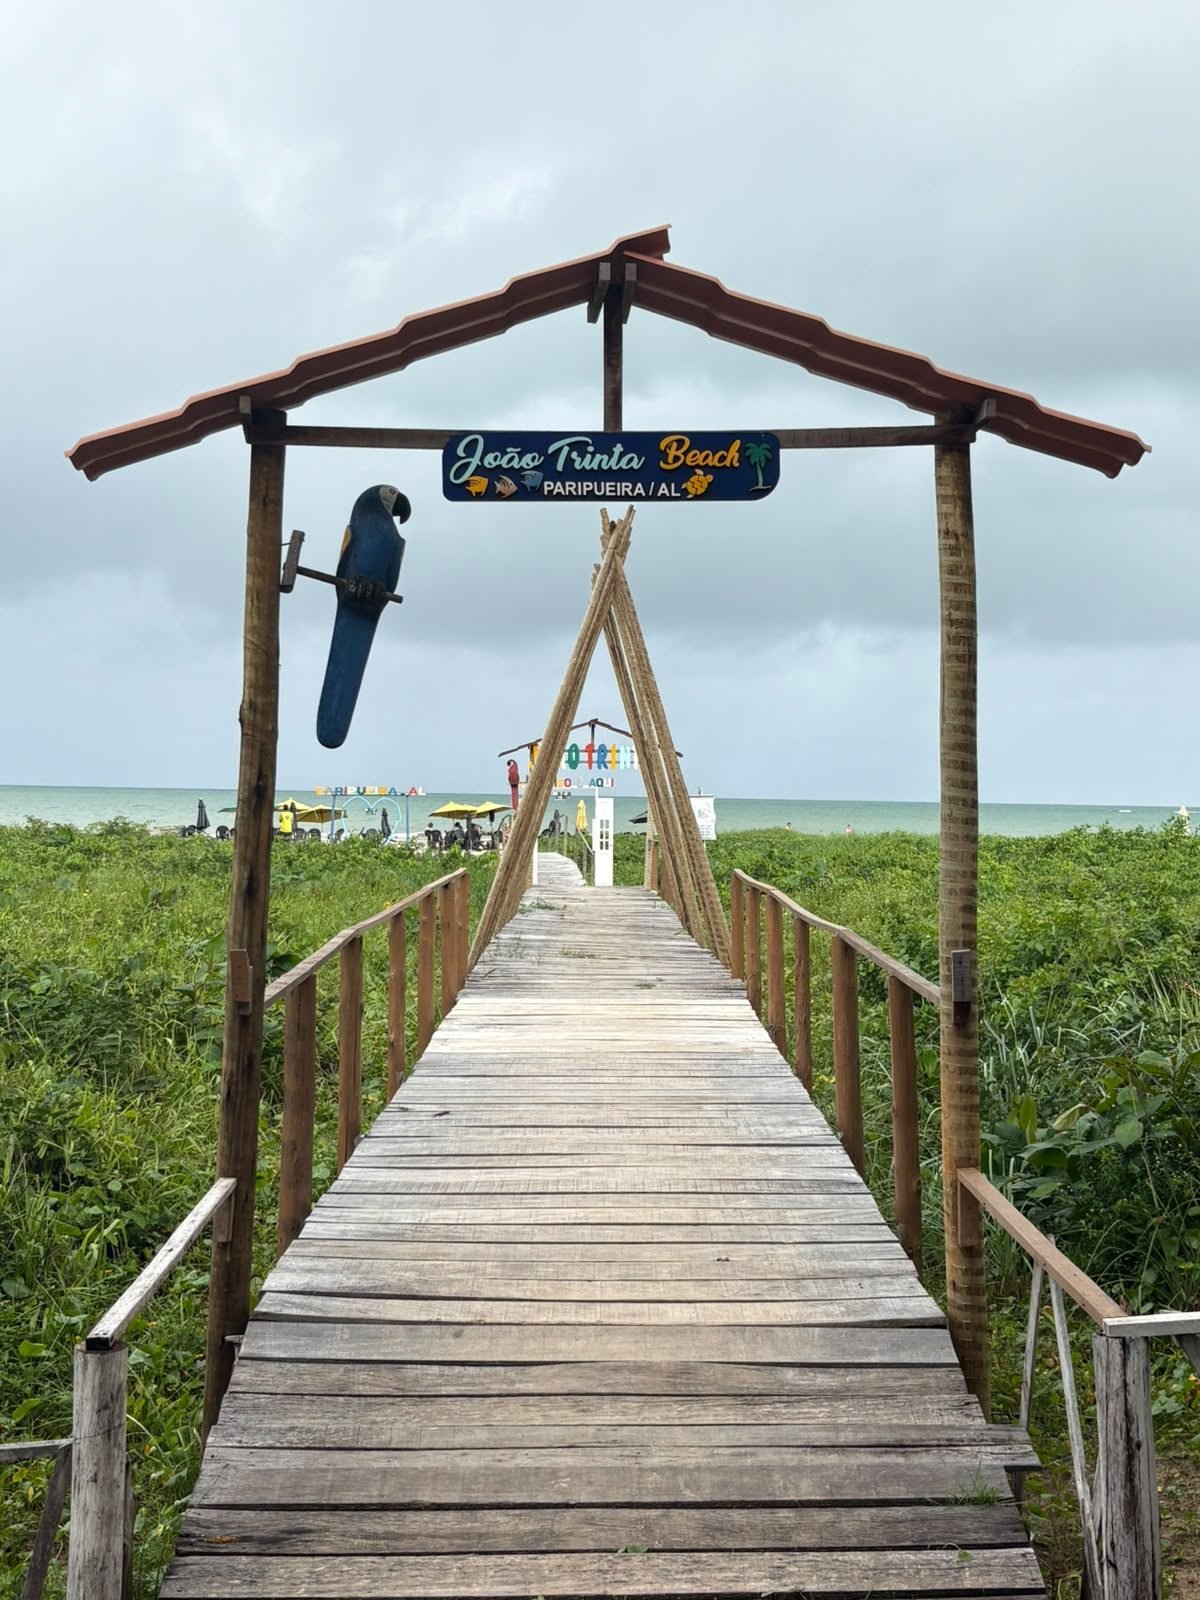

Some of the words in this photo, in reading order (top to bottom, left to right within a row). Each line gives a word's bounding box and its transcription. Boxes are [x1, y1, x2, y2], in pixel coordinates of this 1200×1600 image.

[449, 434, 544, 484] João
[547, 436, 646, 472] Trinta
[659, 434, 742, 470] Beach
[543, 480, 644, 496] PARIPUEIRA
[657, 482, 681, 497] AL
[584, 743, 639, 770] TRIN
[589, 778, 614, 788] AQUI
